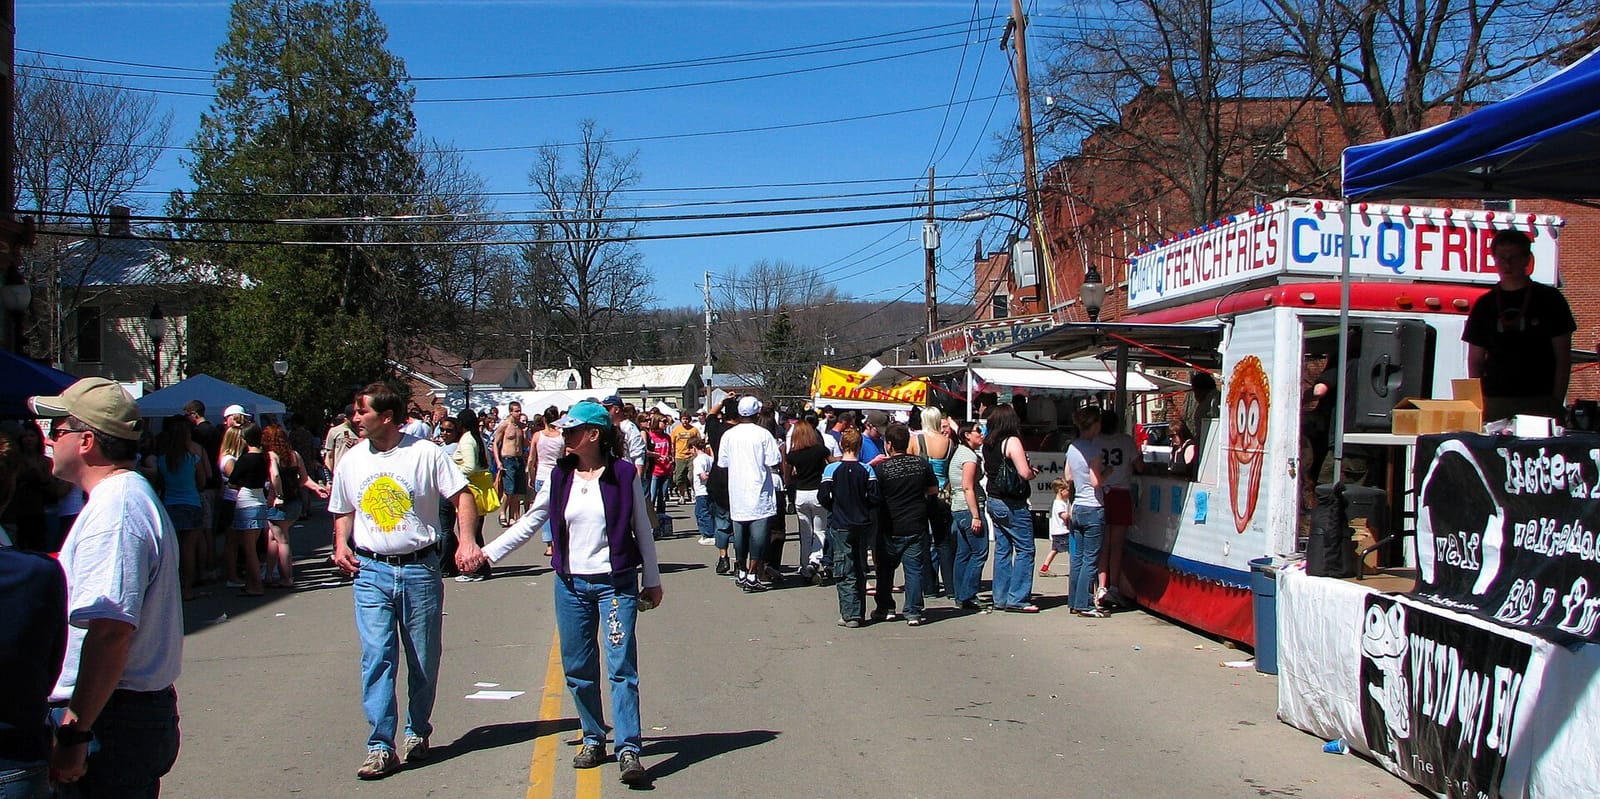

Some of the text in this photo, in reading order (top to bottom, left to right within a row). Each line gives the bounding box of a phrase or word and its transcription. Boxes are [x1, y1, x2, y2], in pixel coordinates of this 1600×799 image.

[1292, 217, 1536, 275] CURLY Q FRIE
[1156, 255, 1165, 297] Q
[825, 384, 926, 402] SANDWICH
[1497, 447, 1587, 498] listen
[371, 524, 407, 533] FINISHER
[1436, 530, 1480, 570] walf
[1411, 754, 1435, 774] The
